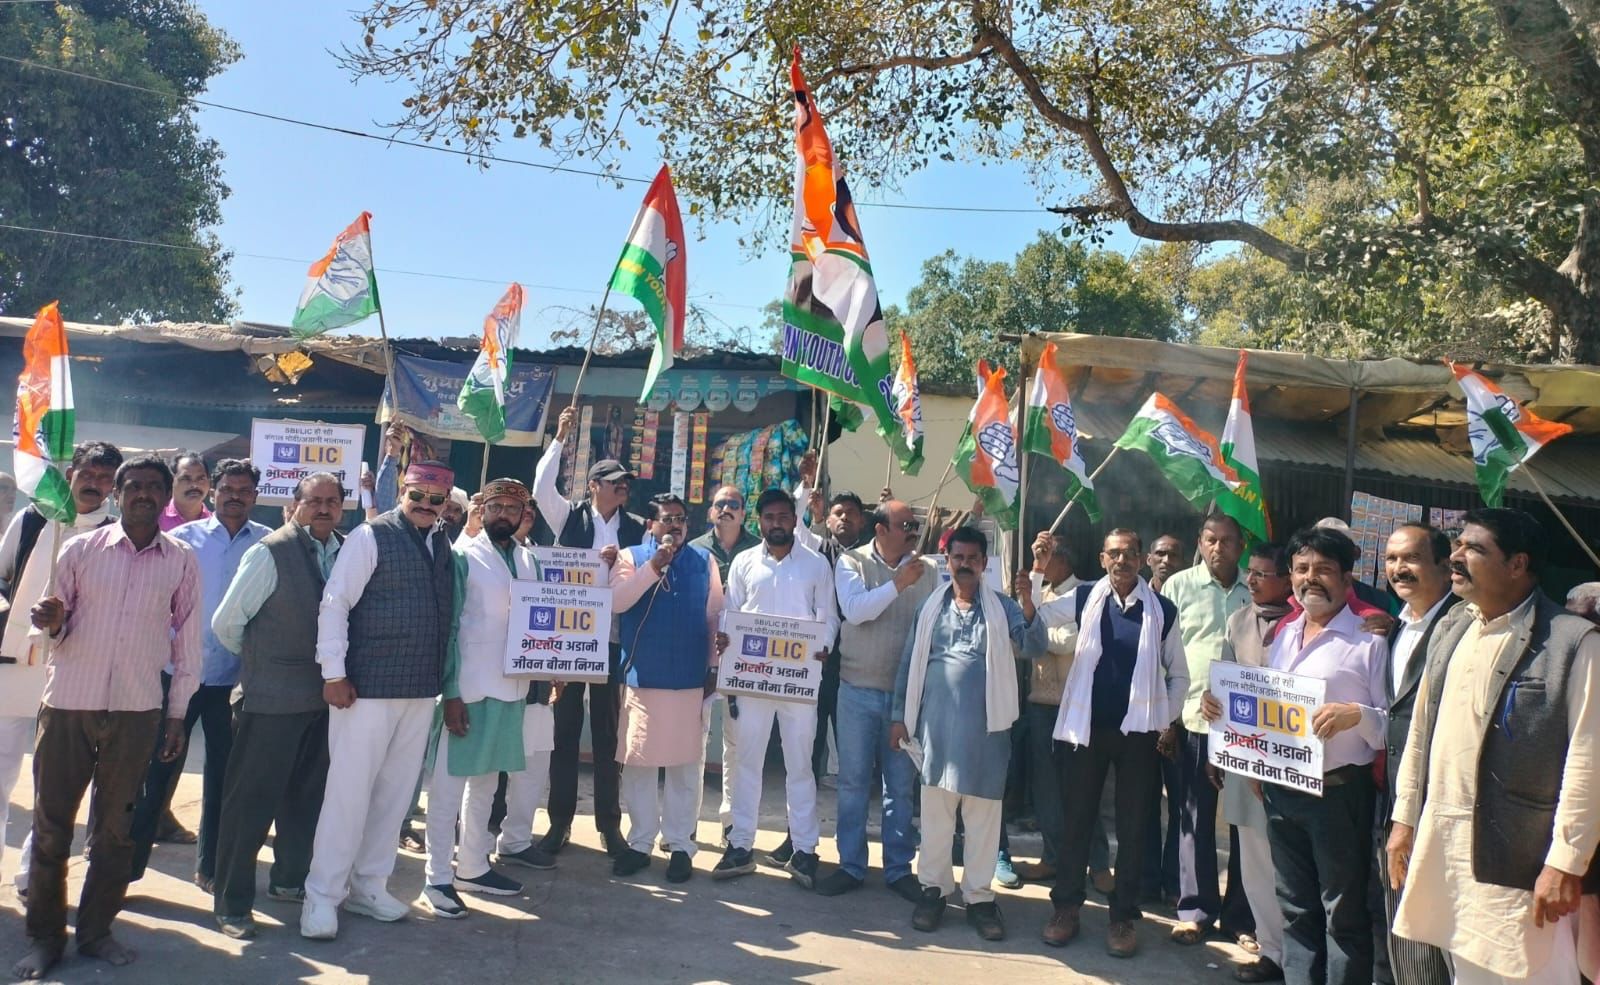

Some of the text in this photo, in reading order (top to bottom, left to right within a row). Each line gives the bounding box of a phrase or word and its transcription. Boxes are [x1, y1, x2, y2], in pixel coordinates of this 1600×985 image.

[801, 330, 844, 380] YOUTH
[304, 446, 338, 463] LIC
[256, 483, 288, 496] जीवन
[559, 610, 592, 631] LIC
[521, 637, 599, 653] भारतीय अडानी
[771, 639, 802, 659] LIC
[512, 656, 606, 672] जीवन बीमा निगम
[734, 660, 809, 680] भारतीय अडानी
[725, 676, 815, 697] जीवन बीमा निगम
[1240, 670, 1295, 689] SBI/LIC हो रही
[1219, 678, 1316, 706] कंगाल मोदी/अडानी मालामाल
[1263, 702, 1300, 733] LIC
[1223, 730, 1312, 764] भारतीय अडानी
[1215, 750, 1322, 792] जीवन बीमा निगम
